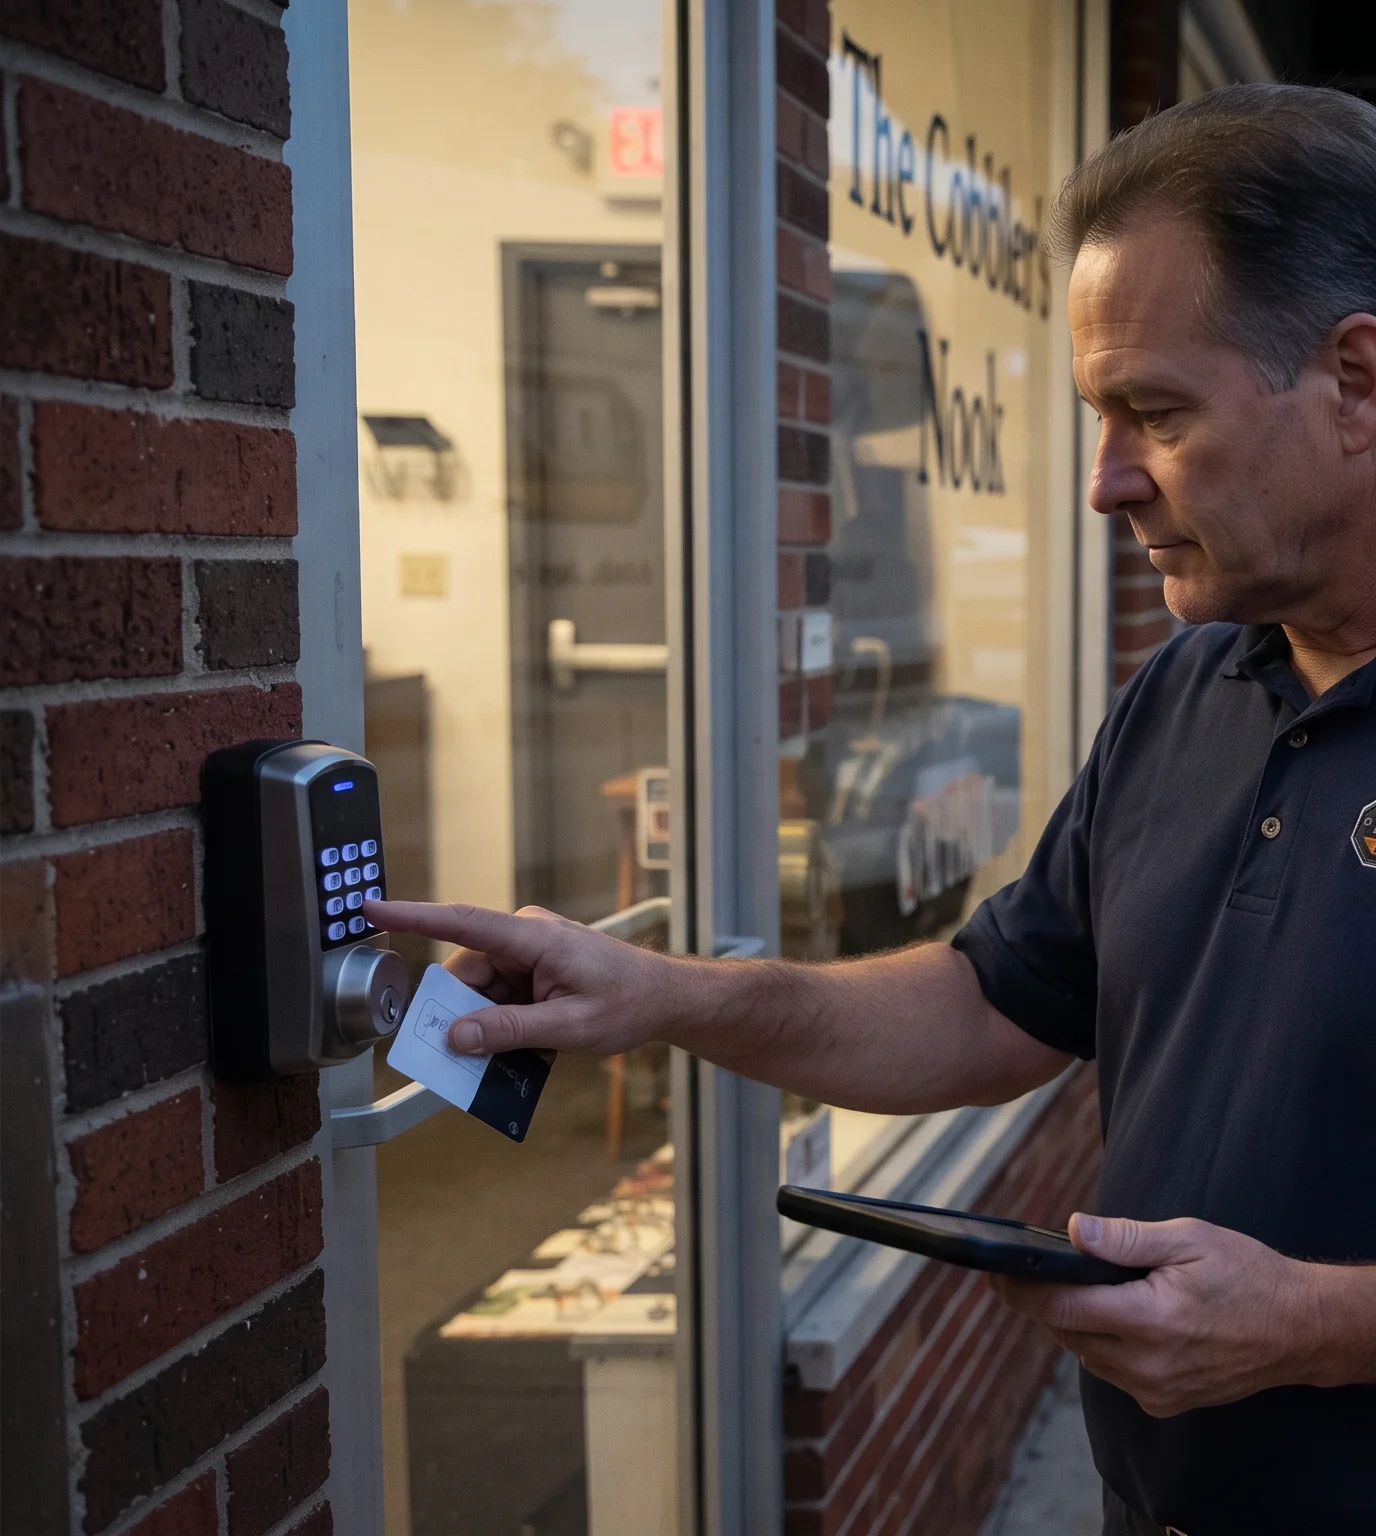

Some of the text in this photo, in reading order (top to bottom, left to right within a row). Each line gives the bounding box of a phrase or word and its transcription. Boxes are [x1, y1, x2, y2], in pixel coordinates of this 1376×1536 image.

[842, 30, 1051, 322] The Cobbler's
[916, 327, 1005, 496] Nook
